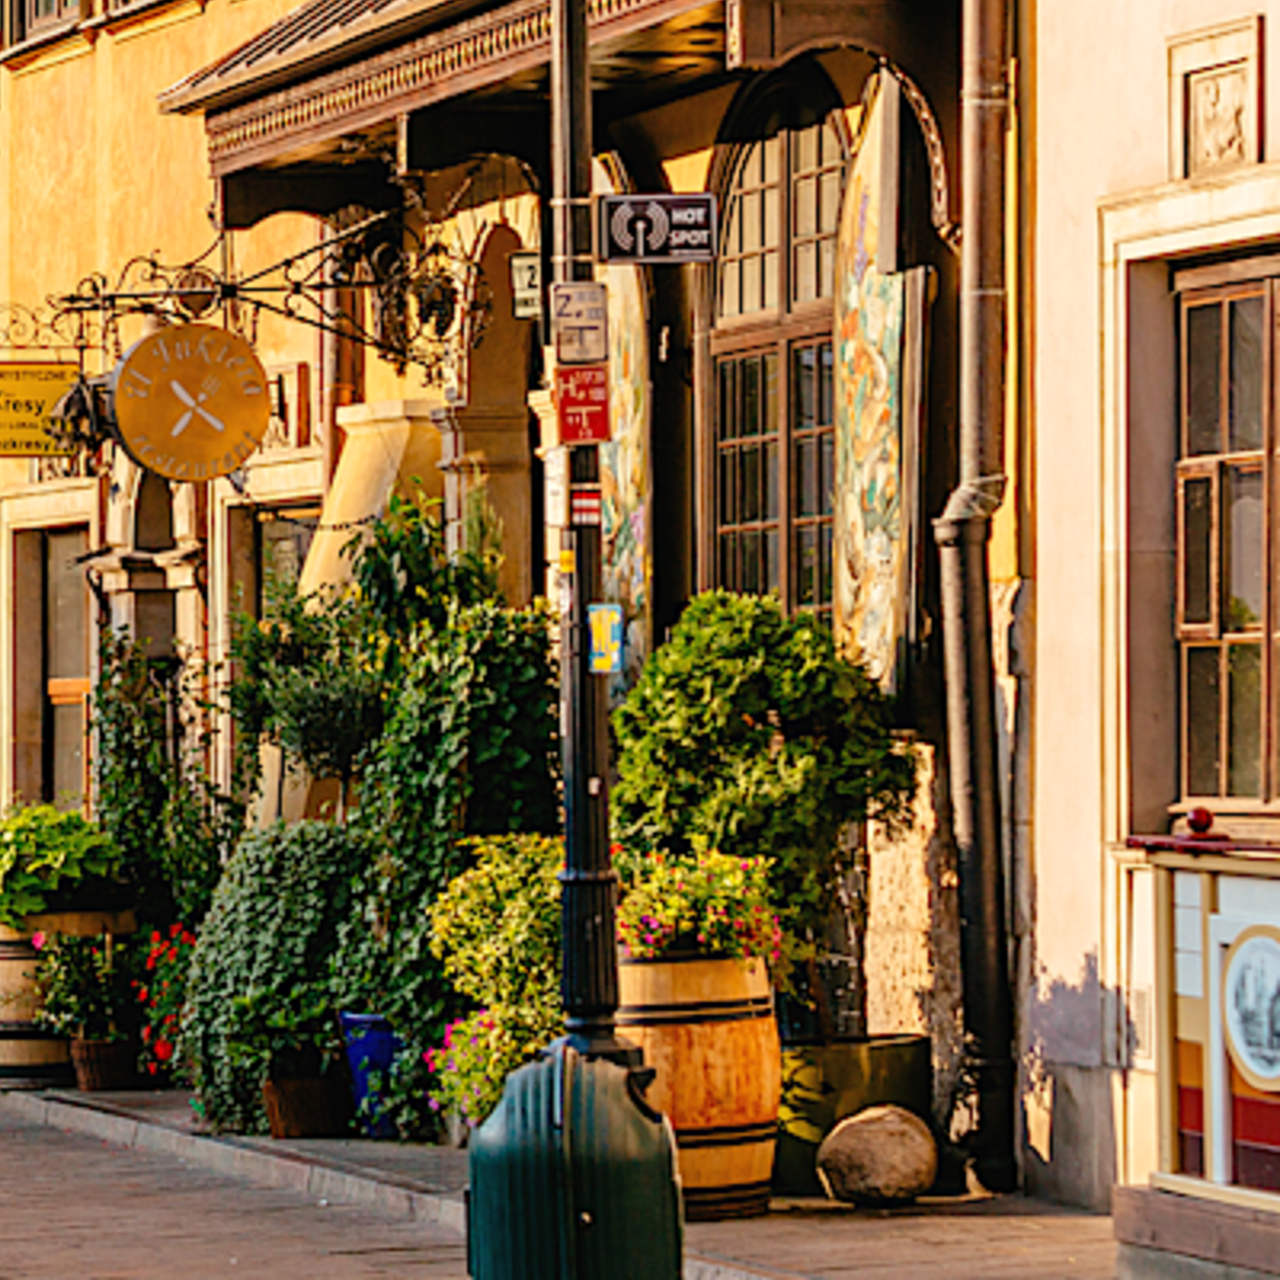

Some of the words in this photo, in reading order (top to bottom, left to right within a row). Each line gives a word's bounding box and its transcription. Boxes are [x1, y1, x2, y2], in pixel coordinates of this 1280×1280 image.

[672, 208, 705, 224] HOT
[671, 230, 708, 247] SPOT
[589, 609, 621, 652] WC
